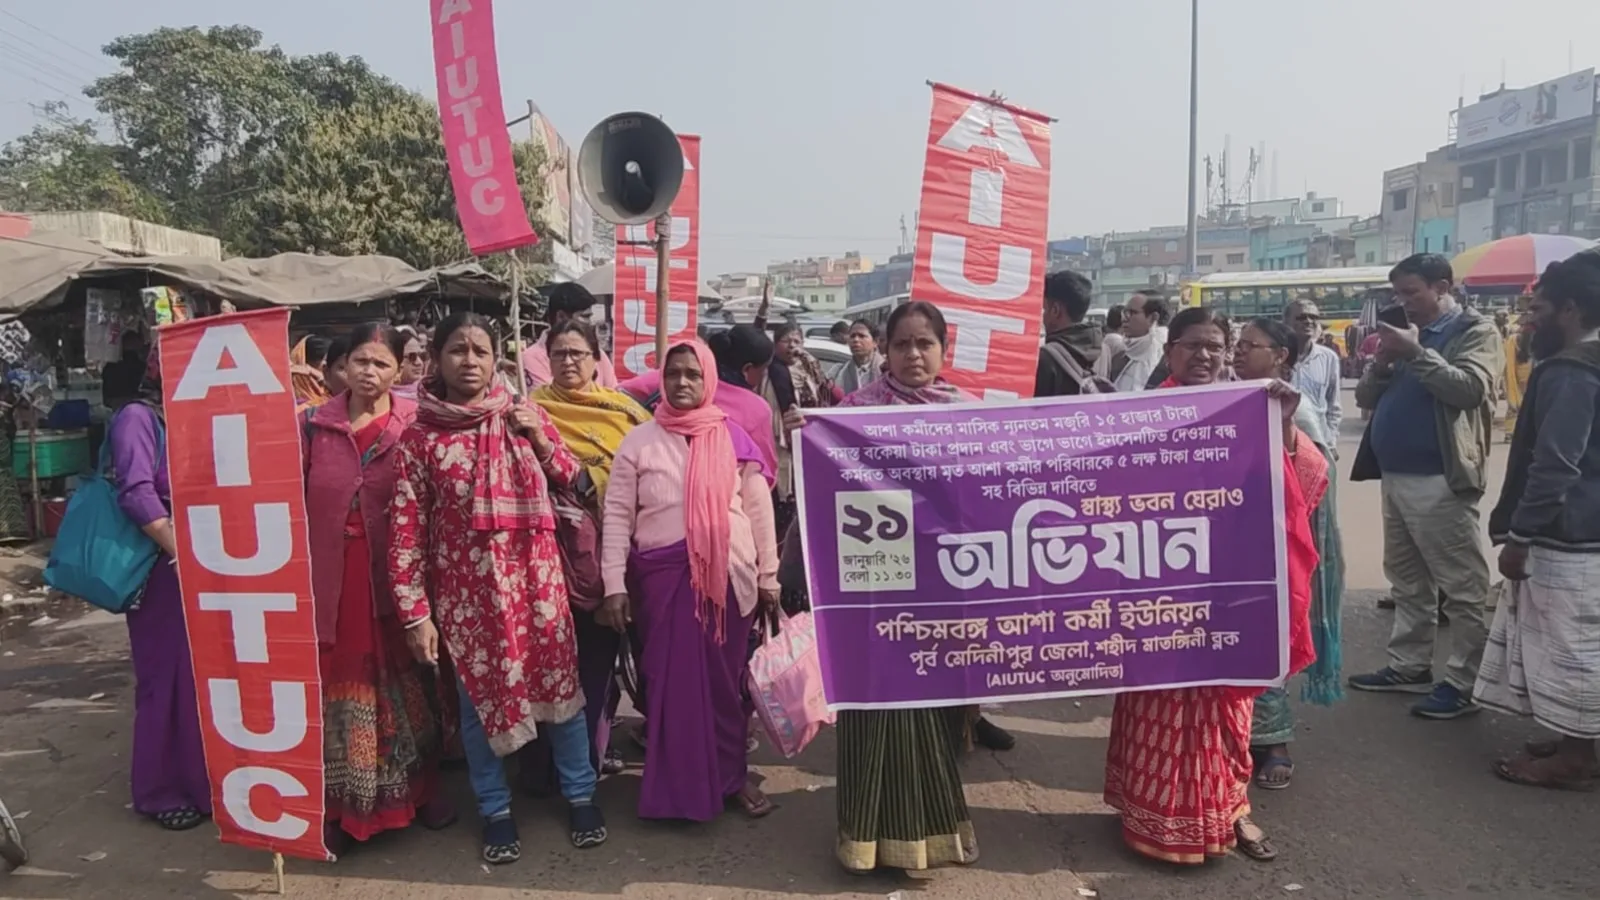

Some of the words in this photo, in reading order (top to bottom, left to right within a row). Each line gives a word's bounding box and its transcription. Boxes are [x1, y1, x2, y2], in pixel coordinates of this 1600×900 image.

[863, 424, 897, 438] আশা
[902, 419, 953, 437] কর্মীদের
[957, 417, 999, 435] মাসিক
[1052, 411, 1090, 432] মজুরি
[1096, 414, 1116, 427] ১৫
[1119, 409, 1163, 426] হাজার
[1165, 405, 1198, 421] টাকা
[826, 447, 861, 461] সমস্ত
[864, 444, 907, 460] বকেয়া
[911, 442, 942, 458] টাকা
[947, 441, 984, 459] প্রদান
[988, 440, 1014, 454] এবং
[1018, 437, 1054, 453] ভাগে
[1057, 434, 1093, 450] ভাগে
[1172, 425, 1211, 441] দেওয়া
[1215, 424, 1238, 440] বন্ধ
[840, 464, 884, 483] কর্মরত
[887, 465, 937, 483] অবস্থায়
[941, 465, 964, 483] মৃত
[967, 461, 1001, 477] আশা
[1005, 455, 1042, 475] কর্মীর
[1046, 453, 1114, 473] পরিবারকে
[1118, 454, 1127, 468] ৫
[1131, 451, 1157, 467] লক্ষ
[1159, 447, 1189, 464] টাকা
[1192, 446, 1230, 462] প্রদান
[981, 484, 1003, 500] সহ
[1006, 477, 1047, 497] বিভিন্ন
[1050, 474, 1098, 495] দাবিতে
[1080, 495, 1122, 518] স্বাস্থ্য
[1129, 491, 1175, 512] ভবন
[1183, 486, 1244, 510] ঘেরাও
[842, 504, 909, 545] ২১
[842, 550, 886, 569] জানুয়ারি
[937, 499, 1211, 590] অভিযান
[172, 323, 310, 840] AIUTUC
[844, 568, 870, 583] বেলা
[875, 612, 989, 642] পশ্চিমবঙ্গ
[995, 609, 1056, 636] আশা
[1063, 597, 1112, 632] কর্মী
[1118, 595, 1212, 630] ইউনিয়ন
[909, 643, 939, 676] পূর্ব
[944, 641, 1034, 669] মেদিনীপুর
[1141, 627, 1206, 653] মাতঙ্গিনী
[1211, 631, 1240, 650] ব্লক
[986, 670, 1046, 688] (AIUTUC
[1050, 662, 1124, 686] অনুমোদিত)
